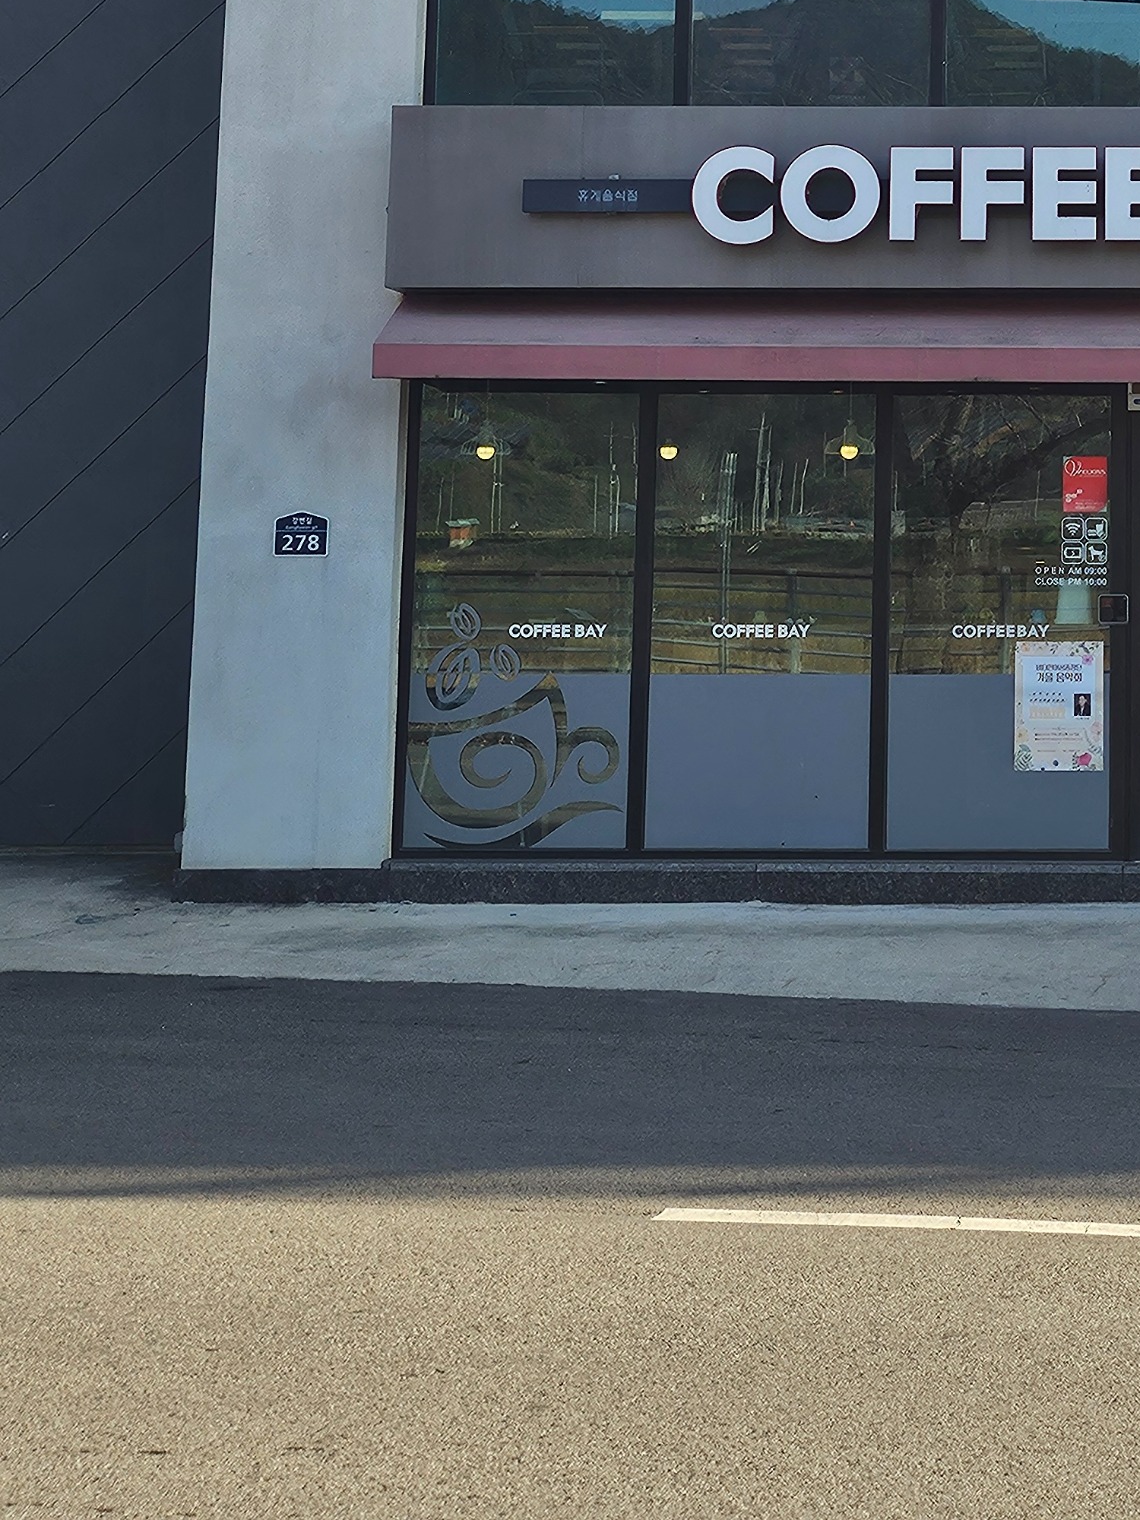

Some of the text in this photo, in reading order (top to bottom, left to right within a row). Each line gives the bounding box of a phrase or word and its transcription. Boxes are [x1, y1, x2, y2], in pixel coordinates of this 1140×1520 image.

[282, 534, 320, 551] 278
[1068, 566, 1082, 575] AM
[1035, 577, 1065, 586] CLOSE
[1068, 577, 1082, 585] PM
[508, 624, 607, 639] COFFEE BAY
[712, 624, 810, 639] COFFEE BAY
